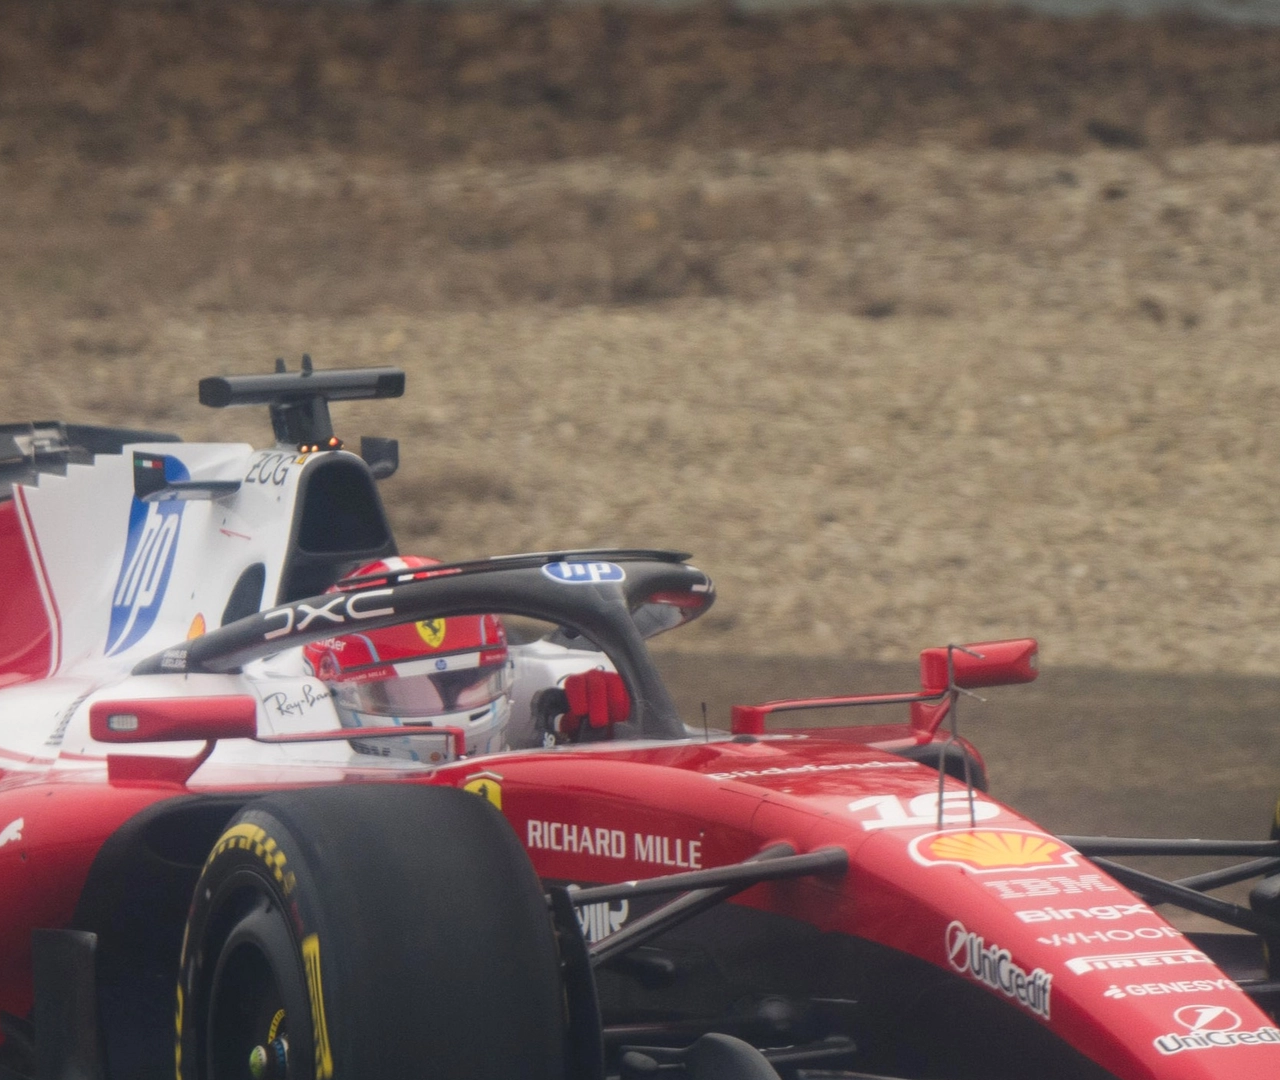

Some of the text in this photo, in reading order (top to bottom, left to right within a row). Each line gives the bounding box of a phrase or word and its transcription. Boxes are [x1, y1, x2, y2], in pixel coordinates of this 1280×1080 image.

[107, 499, 180, 657] hp
[558, 561, 612, 582] hp
[264, 588, 395, 640] DXC
[263, 684, 332, 716] Ray-Ban
[704, 761, 919, 781] Bitdefender
[848, 791, 1001, 831] 16
[527, 819, 702, 869] RICHARD MILLE
[983, 874, 1118, 900] IBM
[1036, 926, 1183, 947] WHOOP
[968, 933, 1052, 1019] UniCredit
[1125, 978, 1244, 998] GENESYS
